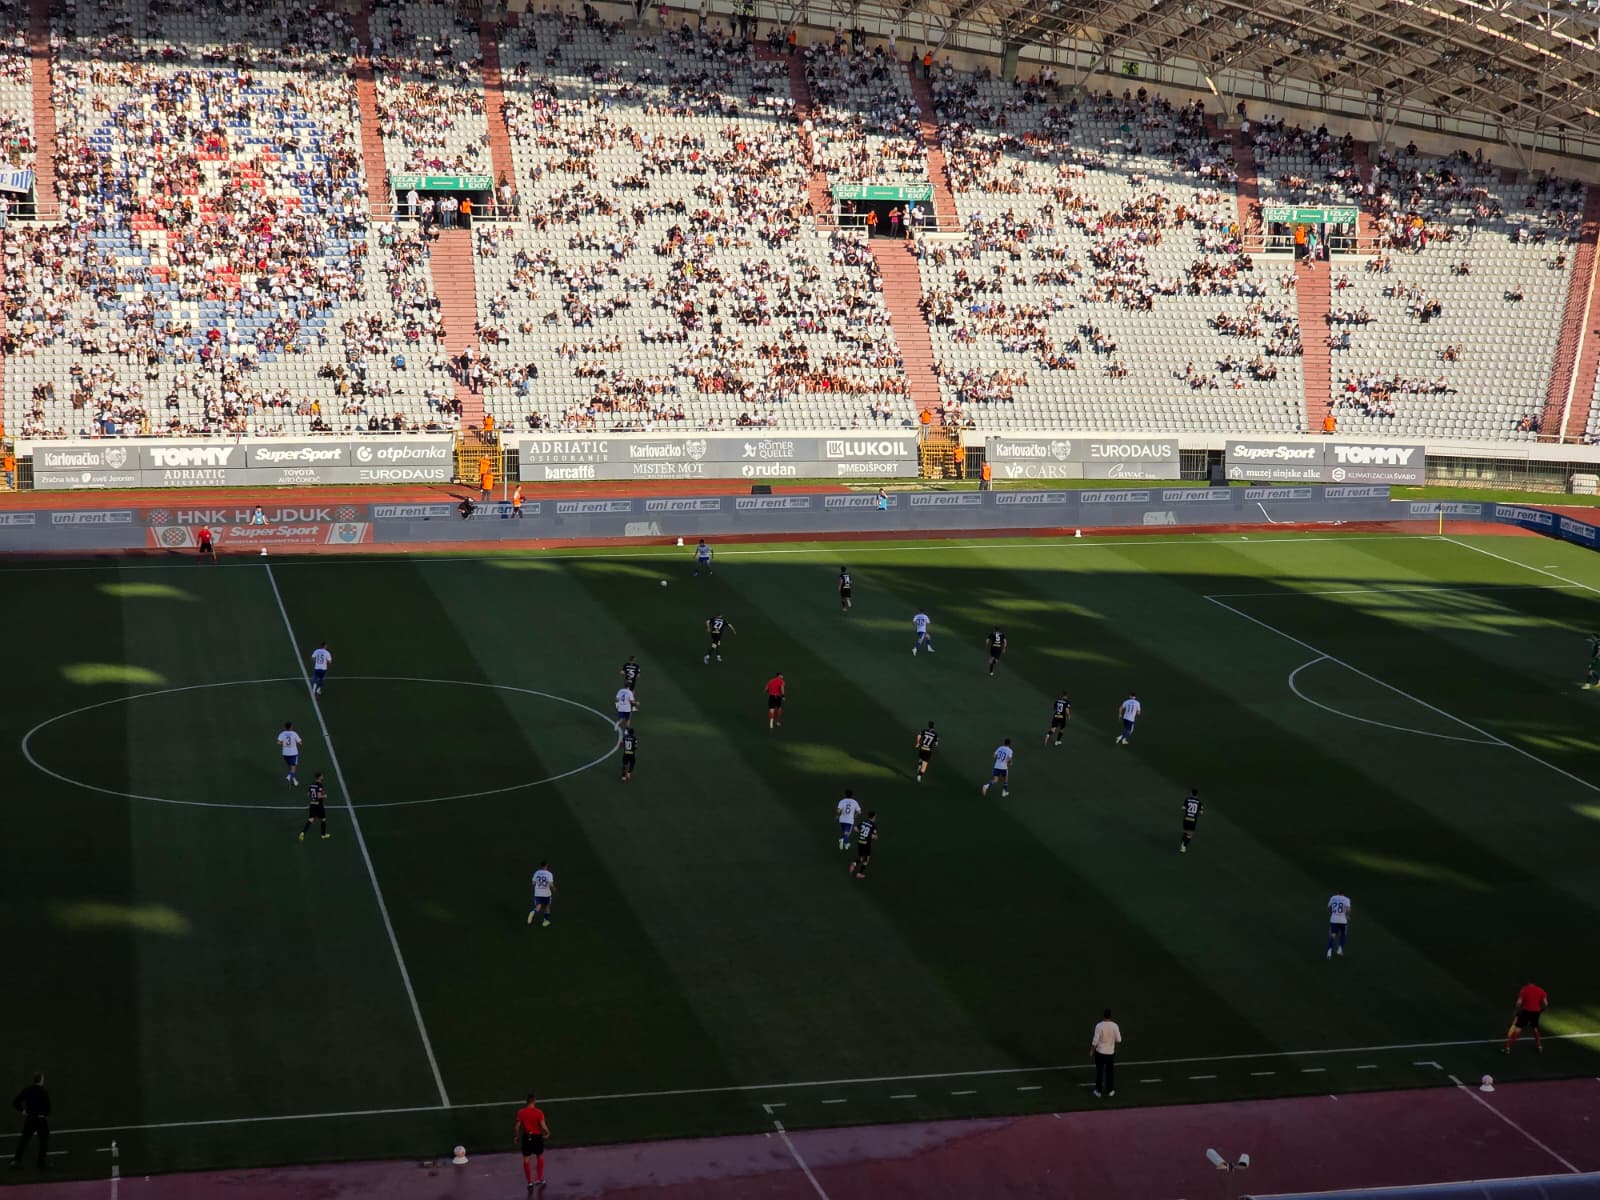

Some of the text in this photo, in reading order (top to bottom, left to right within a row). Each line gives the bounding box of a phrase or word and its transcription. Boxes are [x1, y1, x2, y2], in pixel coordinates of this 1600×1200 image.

[530, 441, 609, 454] ADRIATIC
[629, 444, 682, 458] Karlovačko
[845, 441, 908, 456] LUKOIL
[996, 443, 1047, 457] Karlovačko
[1090, 444, 1172, 457] EURODAUS
[1233, 445, 1316, 460] SuperSport
[45, 452, 100, 466] Karlovačko
[150, 447, 234, 466] TOMMY
[255, 447, 342, 462] SuperSport
[760, 449, 793, 459] QUELLE
[1334, 445, 1416, 465] TOMMY
[633, 462, 675, 474] MISTER
[756, 462, 796, 476] rudan
[1025, 464, 1067, 478] CARS
[164, 469, 226, 479] ADRIATIC
[359, 469, 445, 479] EURODAUS
[1246, 469, 1272, 480] muzej
[1303, 469, 1320, 478] alke
[998, 493, 1045, 503] uni rent
[1083, 493, 1128, 502] uni rent
[1165, 490, 1210, 500] uni rent
[1246, 489, 1292, 498] uni rent
[1326, 488, 1371, 497] uni rent
[648, 500, 668, 510] uni
[671, 500, 697, 509] rent
[737, 498, 786, 508] uni rent
[826, 496, 846, 506] uni
[912, 495, 959, 504] uni rent
[376, 508, 397, 517] uni
[400, 507, 426, 516] rent
[558, 503, 578, 512] uni
[581, 503, 607, 512] rent
[1412, 503, 1431, 513] uni
[54, 513, 76, 523] uni
[80, 512, 107, 522] rent
[177, 508, 332, 524] HNK HJDUK
[1497, 506, 1514, 517] uni
[1517, 510, 1538, 521] rent
[230, 526, 319, 536] SuperSport
